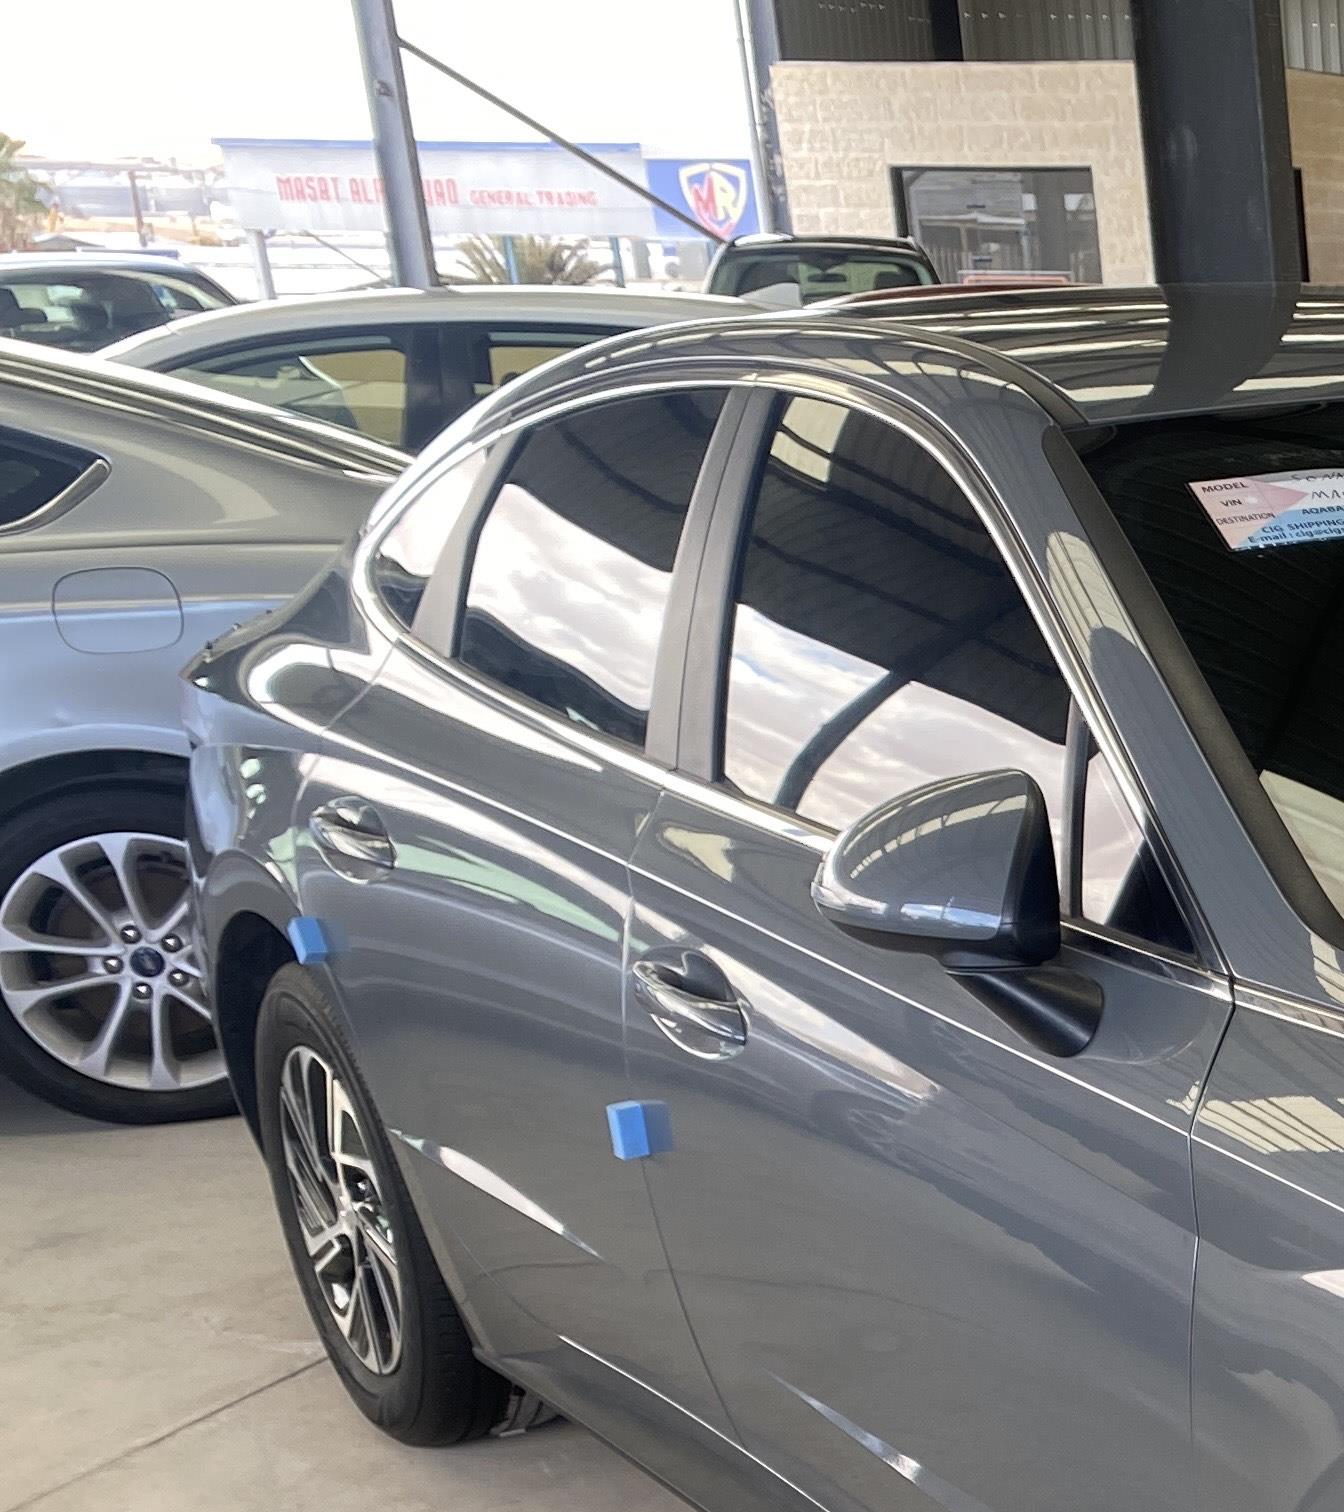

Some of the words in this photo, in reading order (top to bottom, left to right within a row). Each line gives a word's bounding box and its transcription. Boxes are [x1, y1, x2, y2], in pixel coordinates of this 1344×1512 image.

[469, 190, 531, 206] GENERAL
[535, 190, 599, 206] TRADING
[691, 172, 740, 223] MR
[1201, 481, 1249, 493] MODEL
[1219, 498, 1243, 508] VIN
[1215, 511, 1277, 526] DESTINATION
[1301, 506, 1344, 515] AQABA
